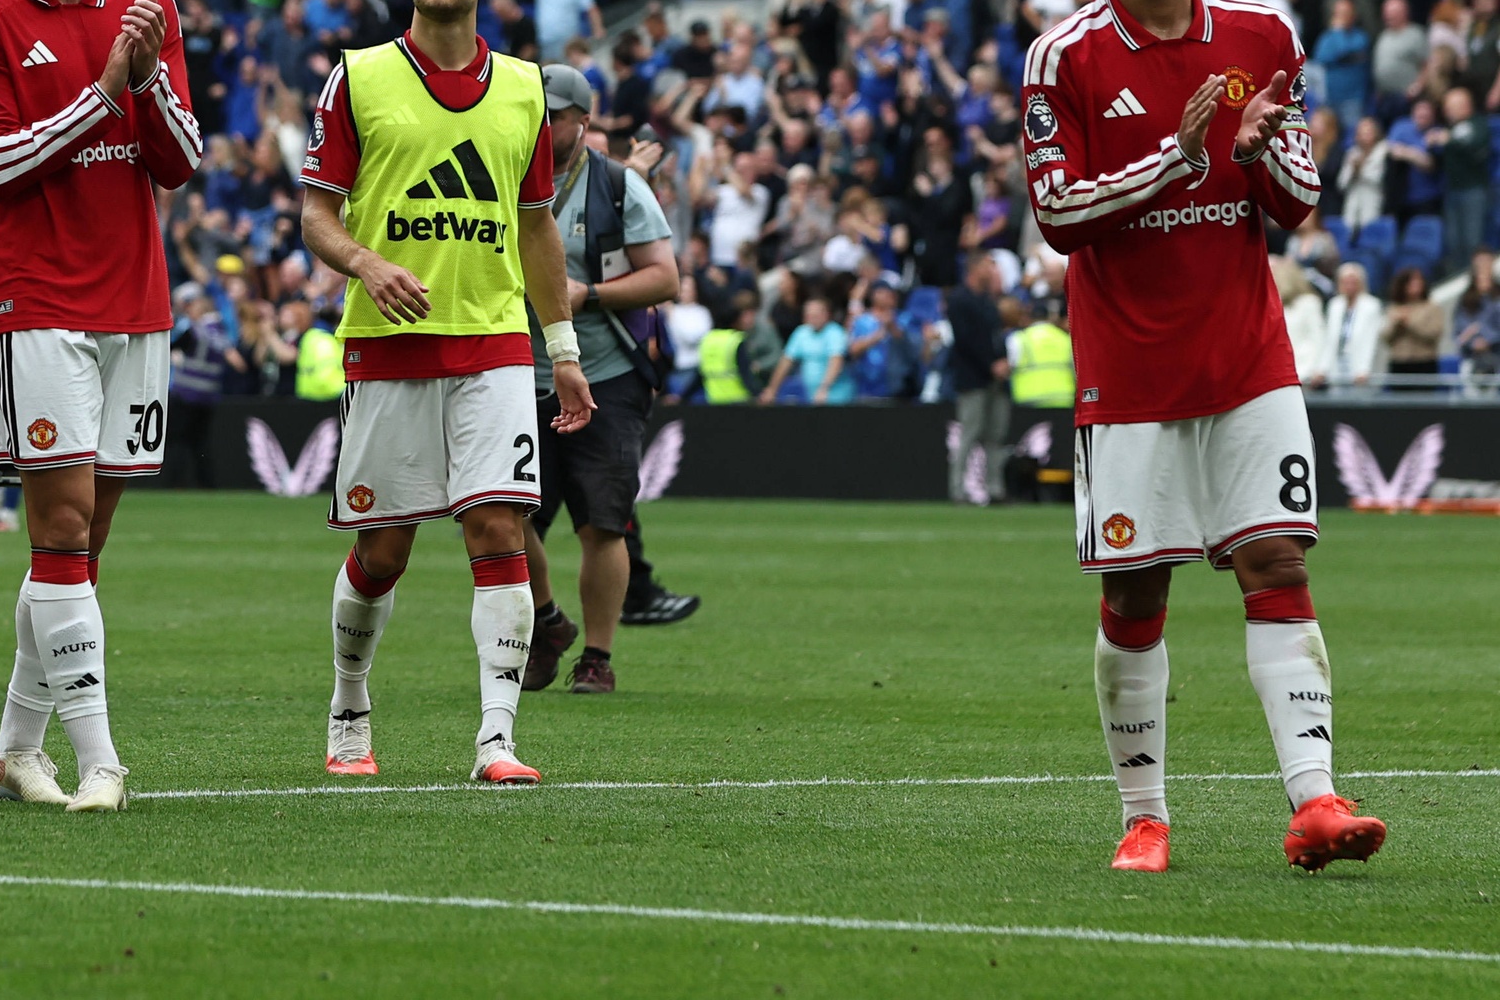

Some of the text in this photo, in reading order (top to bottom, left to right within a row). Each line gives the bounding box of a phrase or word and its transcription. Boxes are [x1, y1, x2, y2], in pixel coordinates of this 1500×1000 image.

[1036, 146, 1060, 156] oom
[387, 210, 507, 254] betway
[126, 399, 163, 456] 30
[513, 433, 536, 482] 2
[1279, 454, 1312, 513] 8
[52, 640, 97, 658] MUFC
[1109, 719, 1156, 734] MUFC
